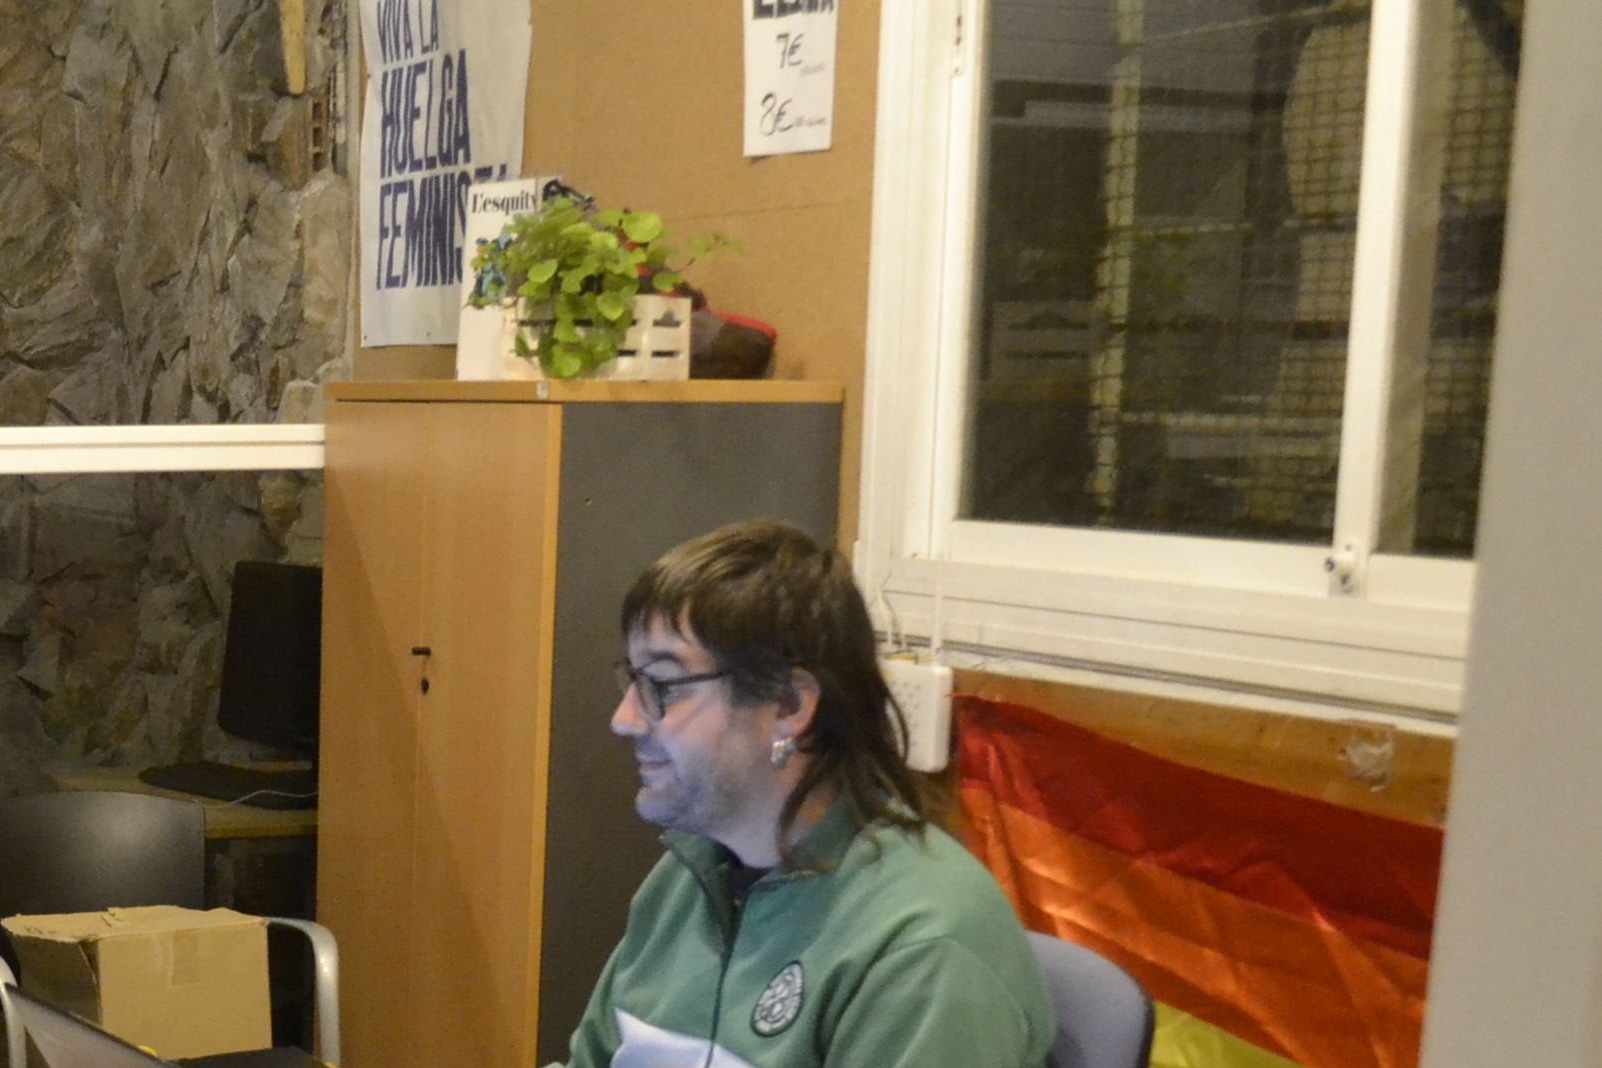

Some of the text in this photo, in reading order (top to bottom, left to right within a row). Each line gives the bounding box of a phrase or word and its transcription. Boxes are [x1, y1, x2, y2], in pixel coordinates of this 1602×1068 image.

[777, 32, 804, 69] 7€
[379, 49, 472, 179] HUELGA
[376, 164, 507, 290] FEMINIS
